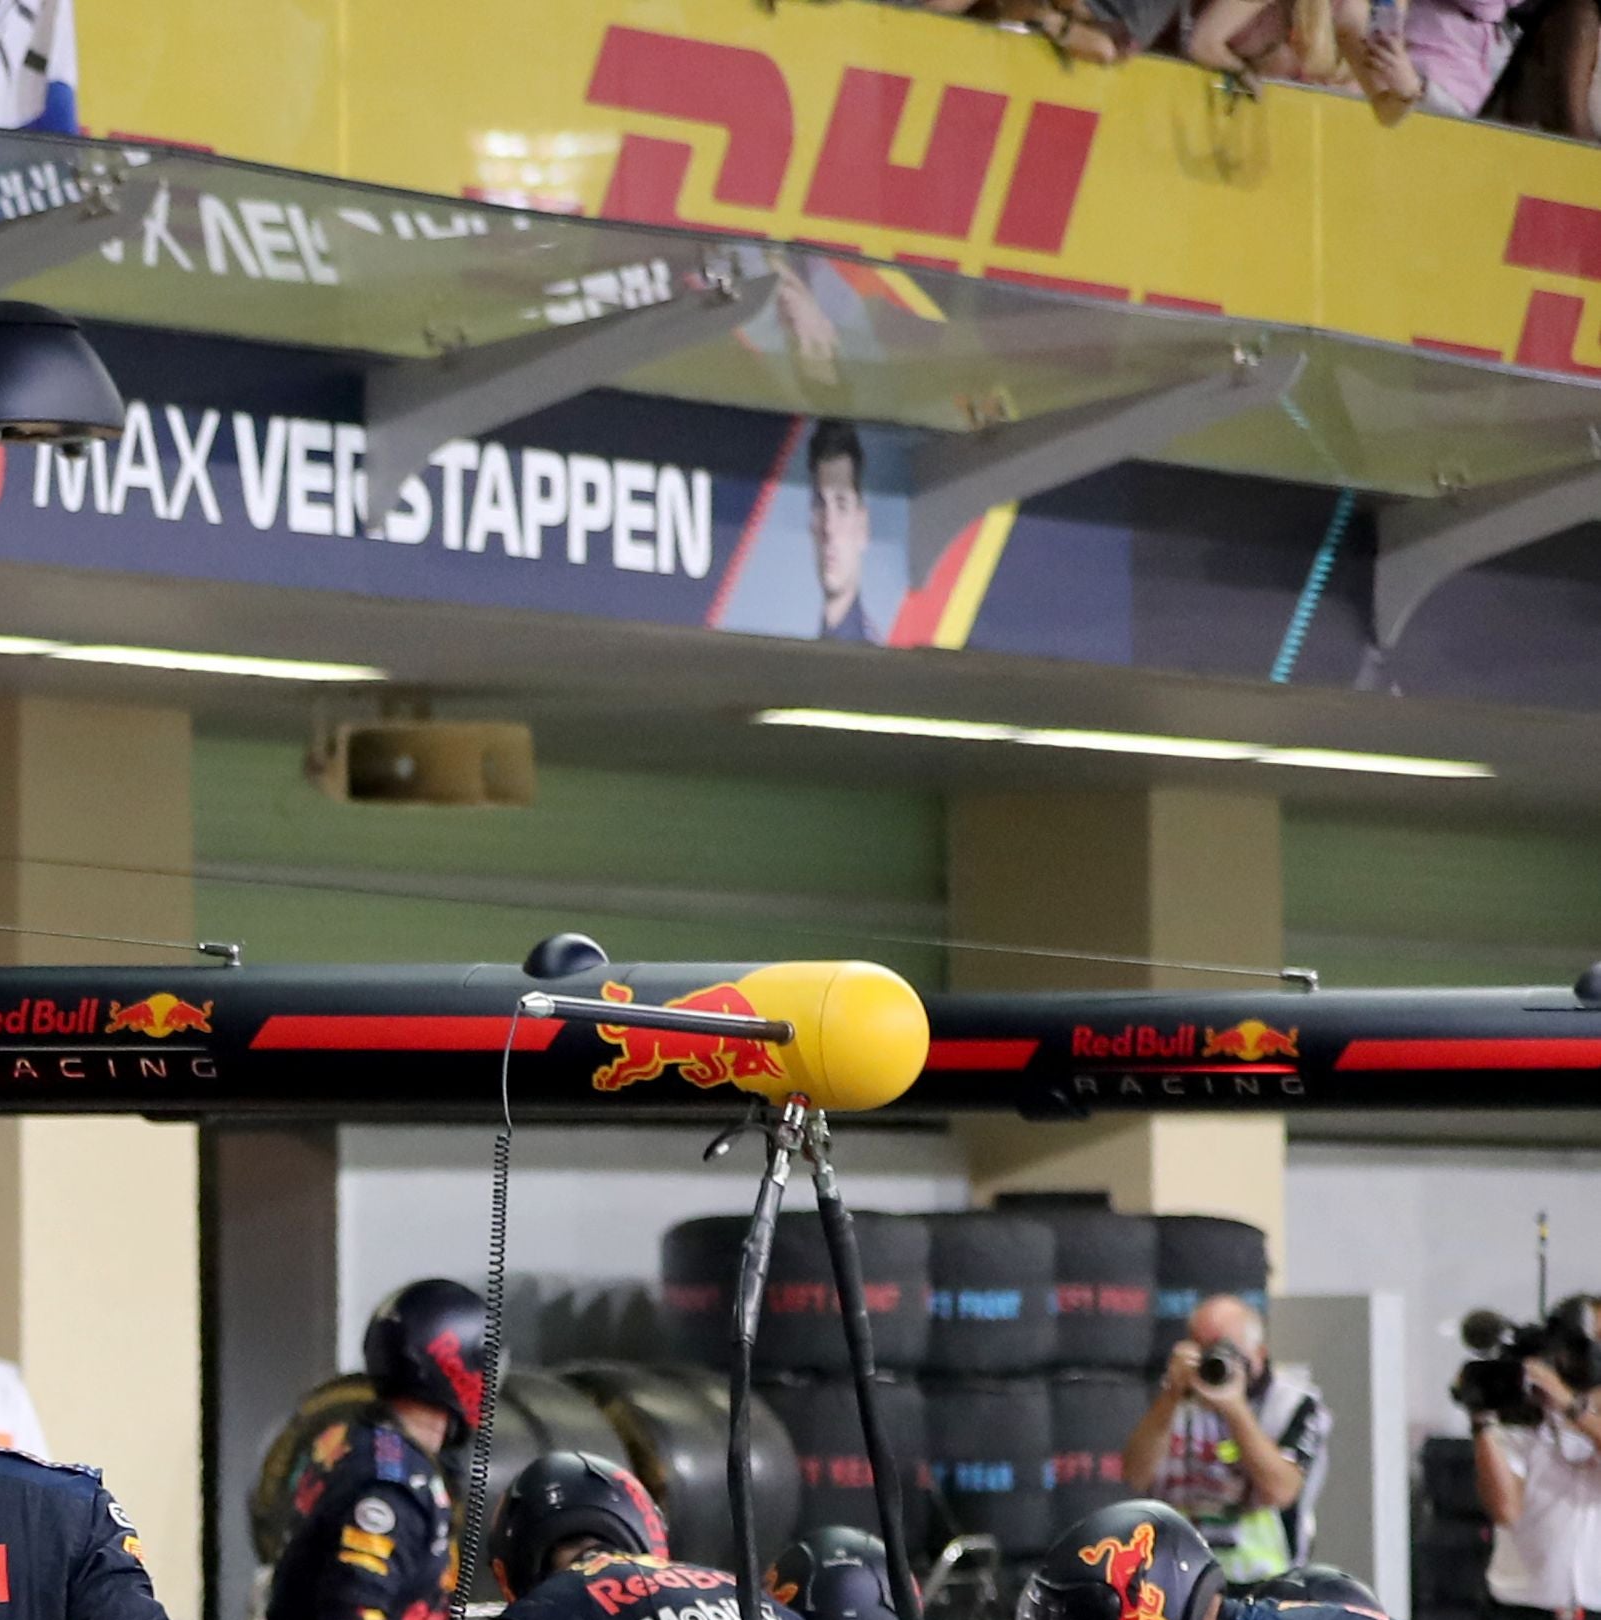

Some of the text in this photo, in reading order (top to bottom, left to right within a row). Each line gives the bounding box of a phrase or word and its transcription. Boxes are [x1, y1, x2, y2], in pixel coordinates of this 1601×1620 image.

[33, 402, 220, 524] MAX
[32, 998, 100, 1034] Bull
[1073, 1076, 1306, 1096] RACING
